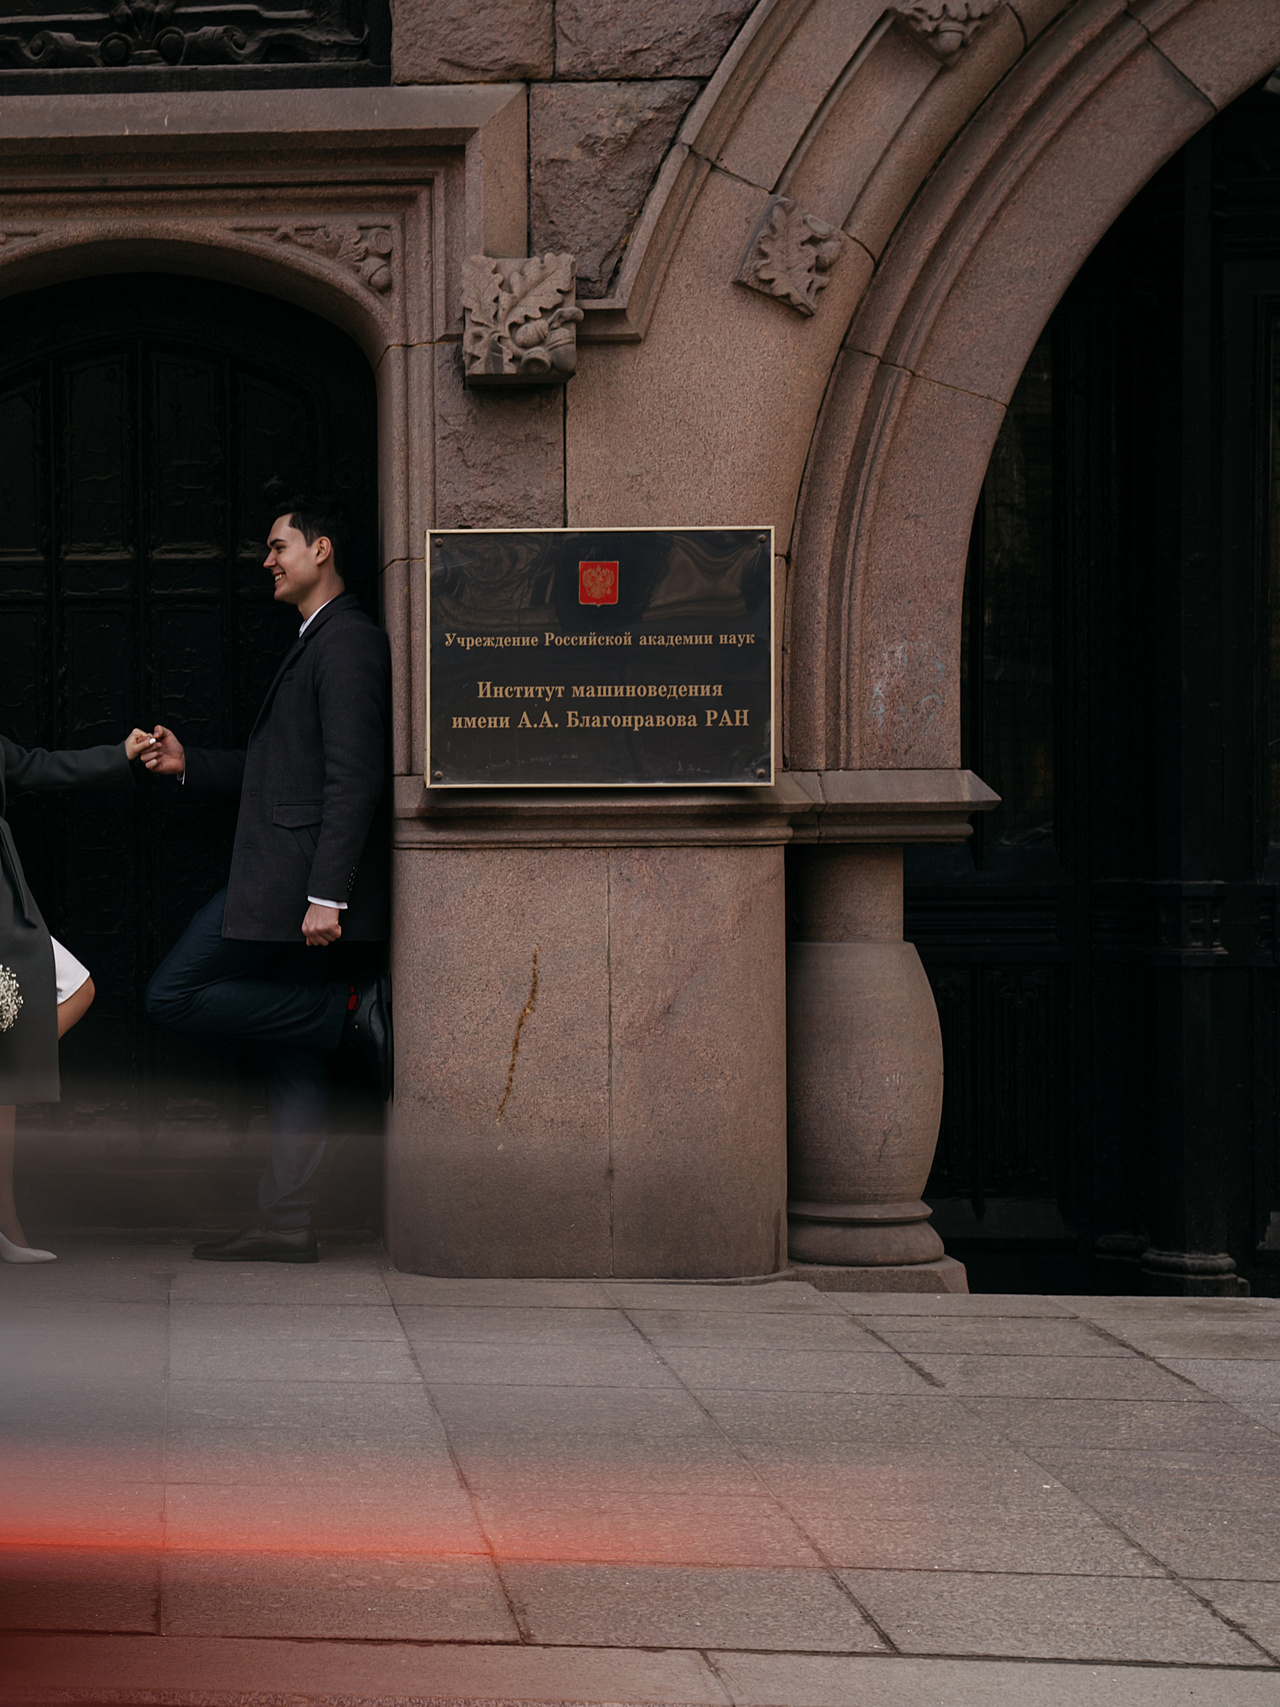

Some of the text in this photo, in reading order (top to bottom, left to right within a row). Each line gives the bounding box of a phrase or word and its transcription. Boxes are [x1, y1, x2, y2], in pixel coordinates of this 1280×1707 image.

[444, 631, 756, 651] Учреждение Российской академии наук
[477, 681, 724, 702] Институт машиноведения
[451, 709, 750, 732] имени А.А. Благонравова РАН
